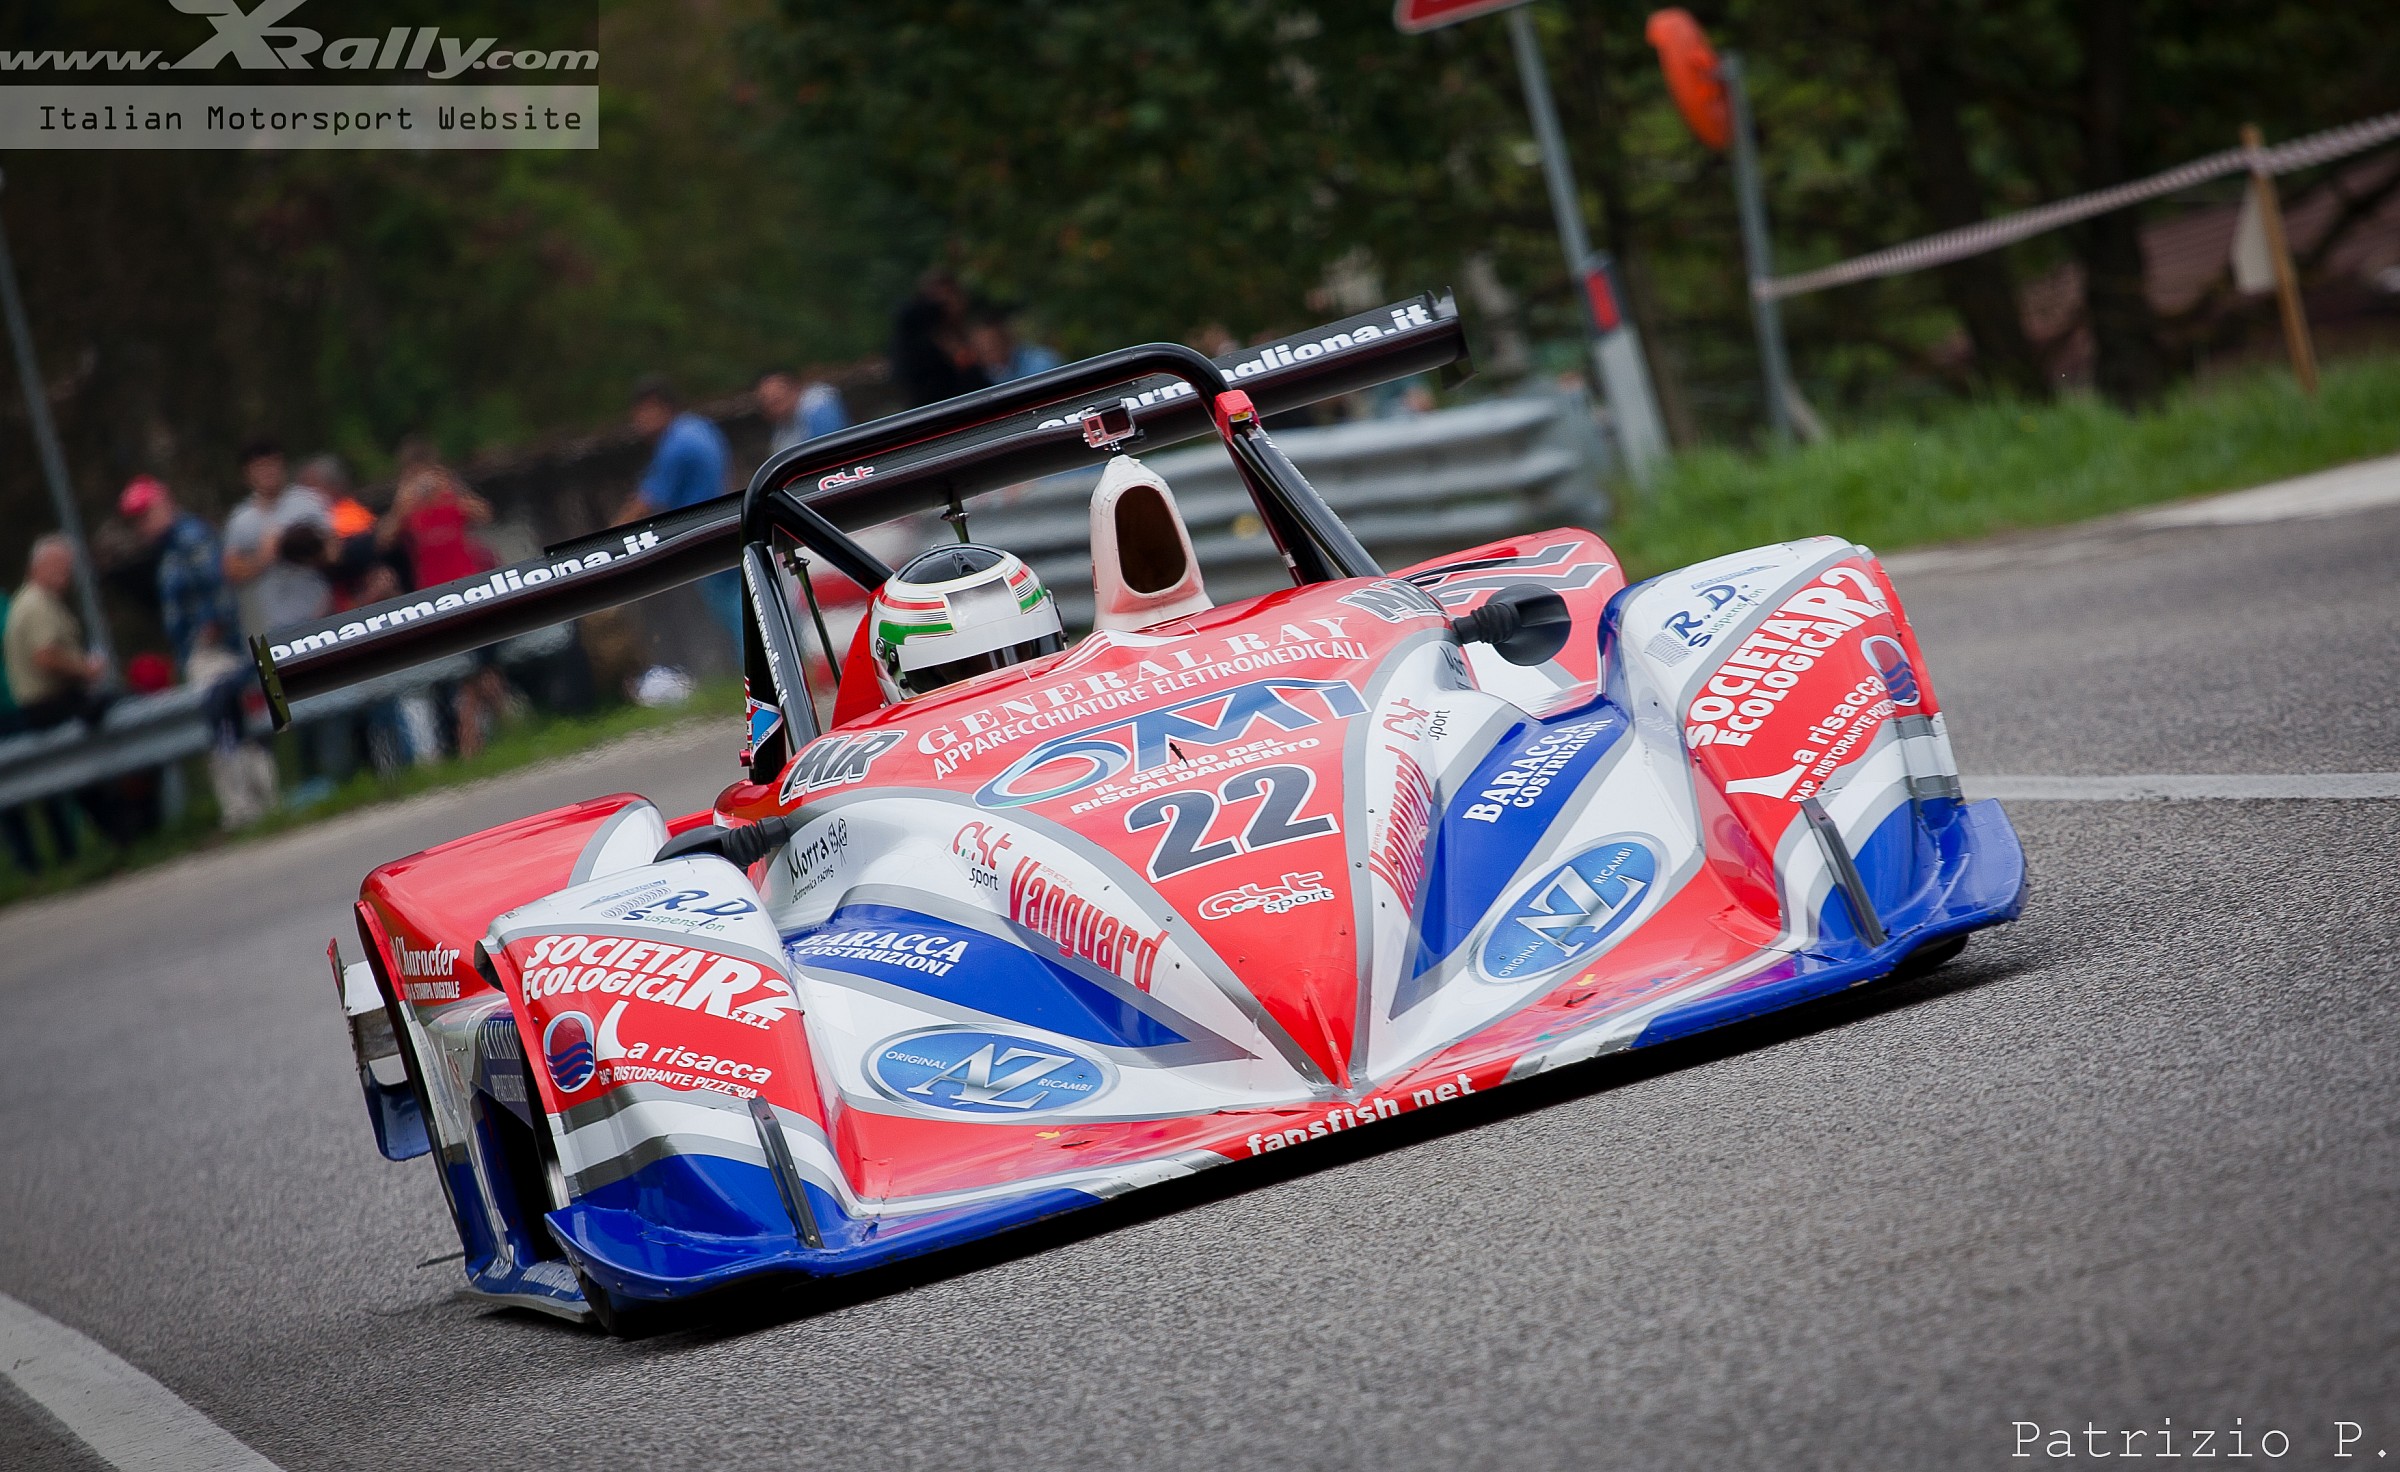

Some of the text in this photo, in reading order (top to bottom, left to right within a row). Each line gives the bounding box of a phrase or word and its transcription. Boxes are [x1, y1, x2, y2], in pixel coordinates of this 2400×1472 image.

[917, 616, 1353, 756] GENERAL RAY
[932, 688, 1150, 781] APPARECCHIATURE
[1160, 640, 1370, 693] ELETTROMEDICALI
[1713, 621, 1853, 747] ECOLOGICA
[1807, 675, 1888, 746] risacca
[1428, 710, 1451, 741] sport
[1811, 715, 1873, 777] RISTORANTE
[1070, 737, 1321, 815] RISCALDAMENTO
[1094, 737, 1286, 797] IL GENIO DEL
[1462, 721, 1595, 827] BARACCA
[1512, 718, 1614, 809] COSTRUZIONI
[1124, 764, 1340, 883] 22
[786, 835, 831, 886] Morra
[968, 867, 999, 891] sport
[1592, 848, 1634, 885] RICAMBI
[1010, 855, 1170, 995] Vanguard
[1263, 886, 1336, 914] sport
[1515, 865, 1647, 958] AZ
[792, 931, 969, 963] BARACCA
[798, 945, 955, 977] COSTRUZIONI
[1498, 940, 1545, 977] ORIGINAL
[522, 966, 687, 1006] ECOLOGICA
[613, 1065, 693, 1087] RISTORANTE
[692, 1076, 759, 1099] PIZZERIA
[652, 1045, 772, 1085] risacca
[885, 1050, 948, 1071] ORIGINAL
[906, 1043, 1076, 1109] AZ
[1037, 1077, 1094, 1093] RICAMBI
